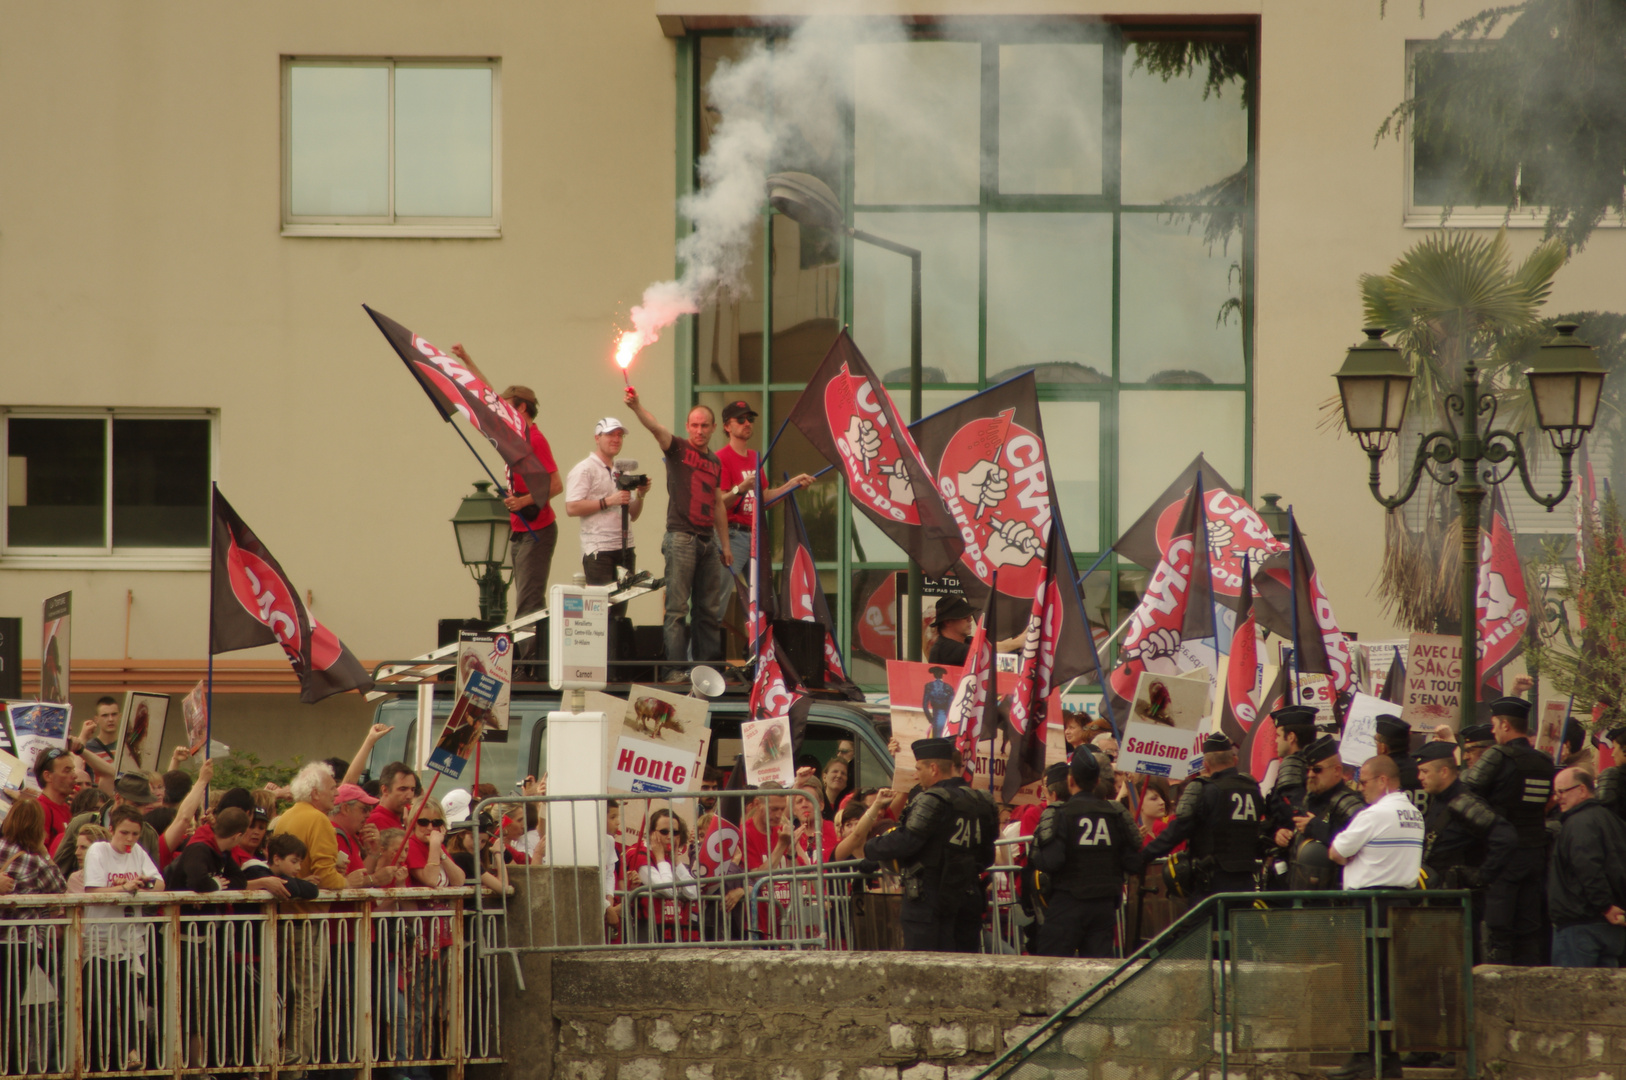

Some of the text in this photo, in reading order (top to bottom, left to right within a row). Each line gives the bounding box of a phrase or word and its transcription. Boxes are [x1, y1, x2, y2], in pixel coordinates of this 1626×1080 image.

[837, 437, 906, 521] europe
[940, 475, 989, 578] europe
[1413, 645, 1448, 659] AVEC
[575, 669, 593, 679] Carnot
[1413, 659, 1462, 679] SANG
[1409, 678, 1463, 693] VA TOUT
[1409, 693, 1459, 707] S'EN VA
[1126, 737, 1188, 761] Sadisme
[617, 748, 687, 785] Honte
[1231, 793, 1257, 821] 2A
[1397, 809, 1424, 823] POLICE
[1079, 817, 1112, 846] 2A
